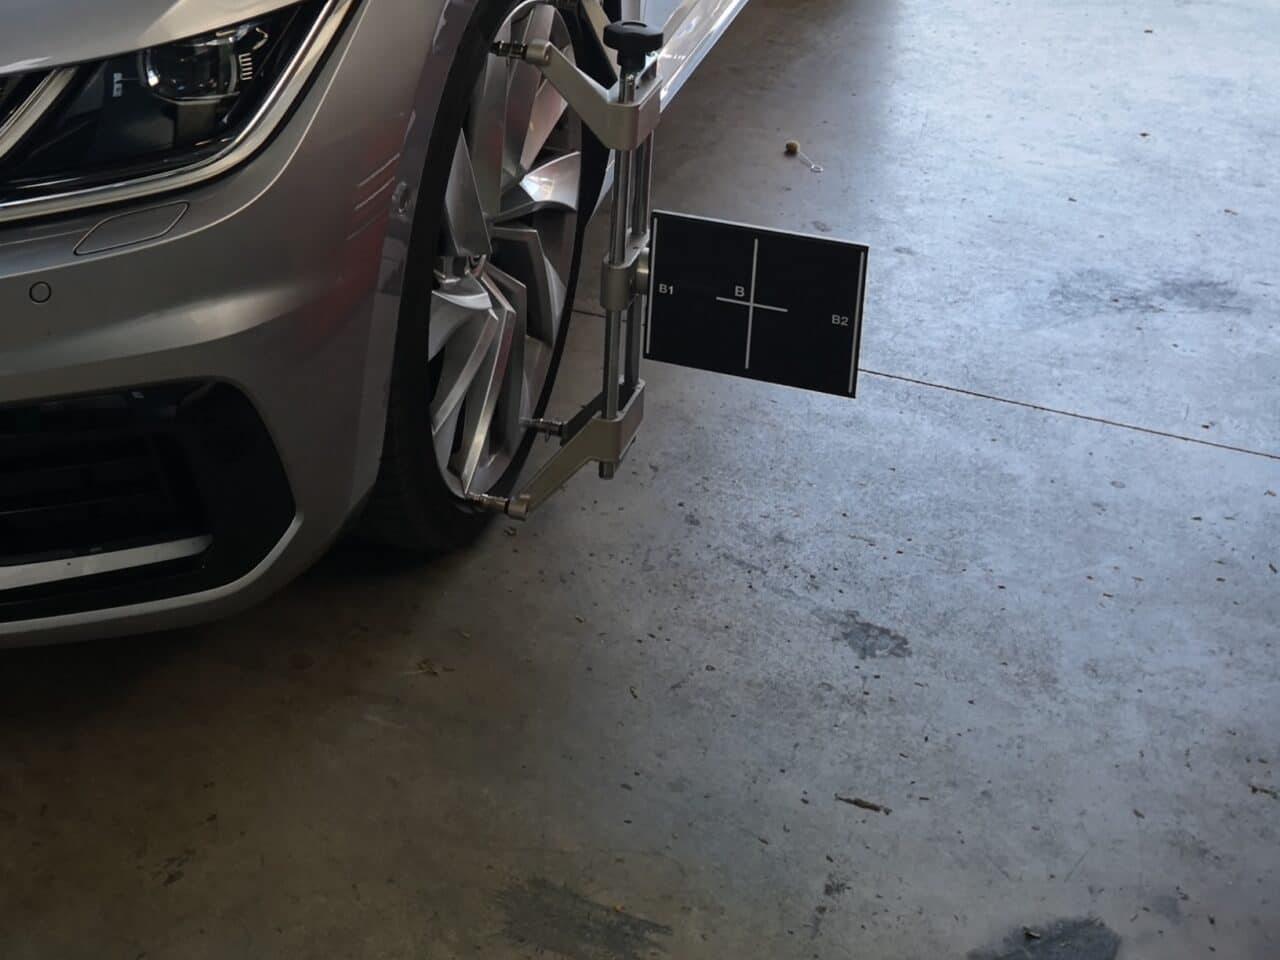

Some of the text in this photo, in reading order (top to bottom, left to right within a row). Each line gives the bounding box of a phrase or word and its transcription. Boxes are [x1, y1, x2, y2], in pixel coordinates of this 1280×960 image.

[658, 283, 674, 295] B1
[735, 286, 745, 297] B
[831, 314, 849, 326] B2
